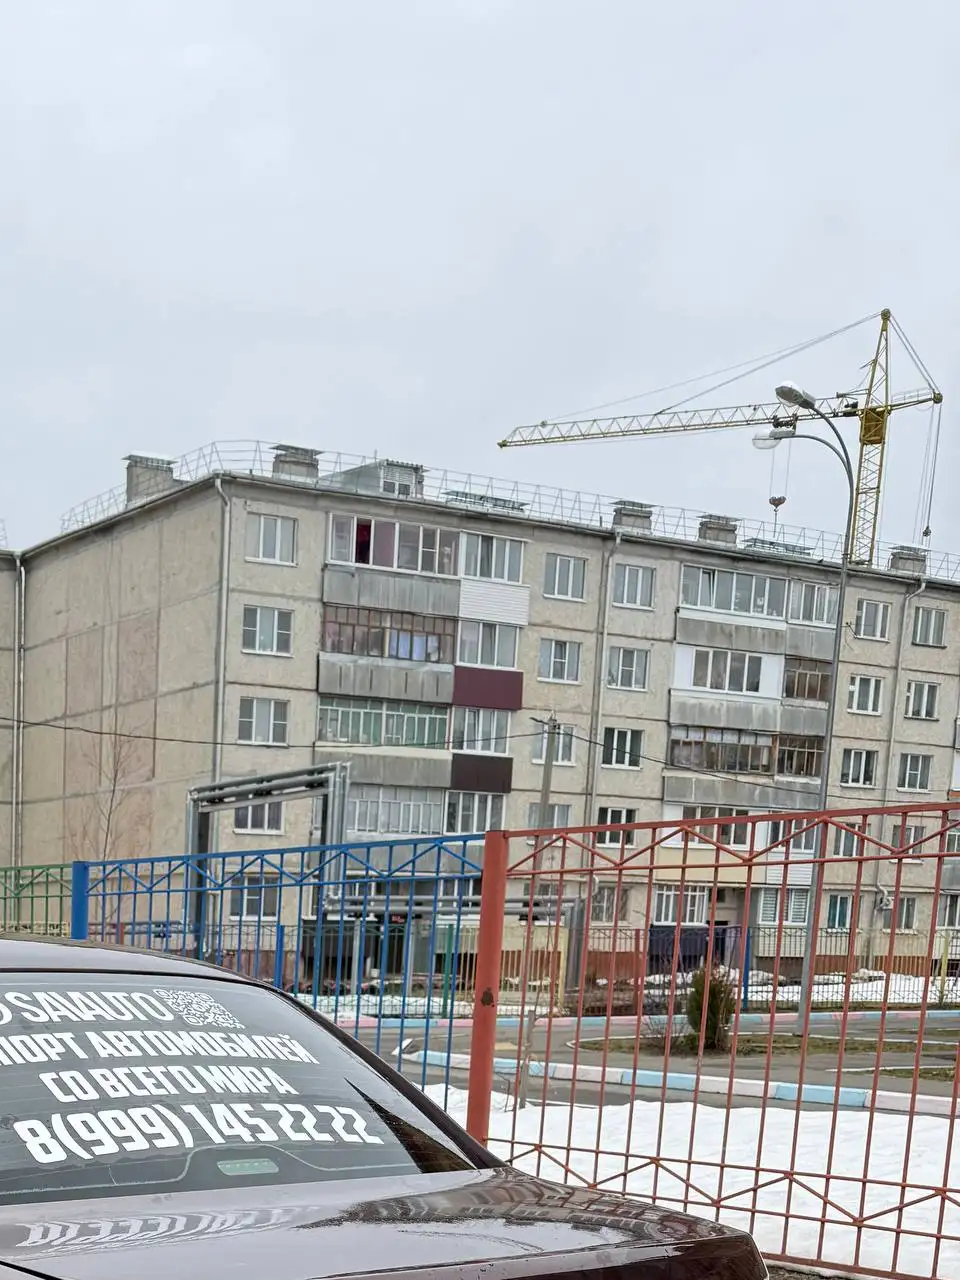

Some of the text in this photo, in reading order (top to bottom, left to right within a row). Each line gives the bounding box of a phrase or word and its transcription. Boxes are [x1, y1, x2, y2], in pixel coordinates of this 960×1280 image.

[4, 991, 174, 1023] SAVAUTO
[85, 1031, 320, 1064] АВТОМОБИЛЕЙ
[39, 1065, 300, 1103] СО ВСЕГО МИРА
[13, 1104, 194, 1164] 8(999)
[180, 1103, 279, 1144] 145
